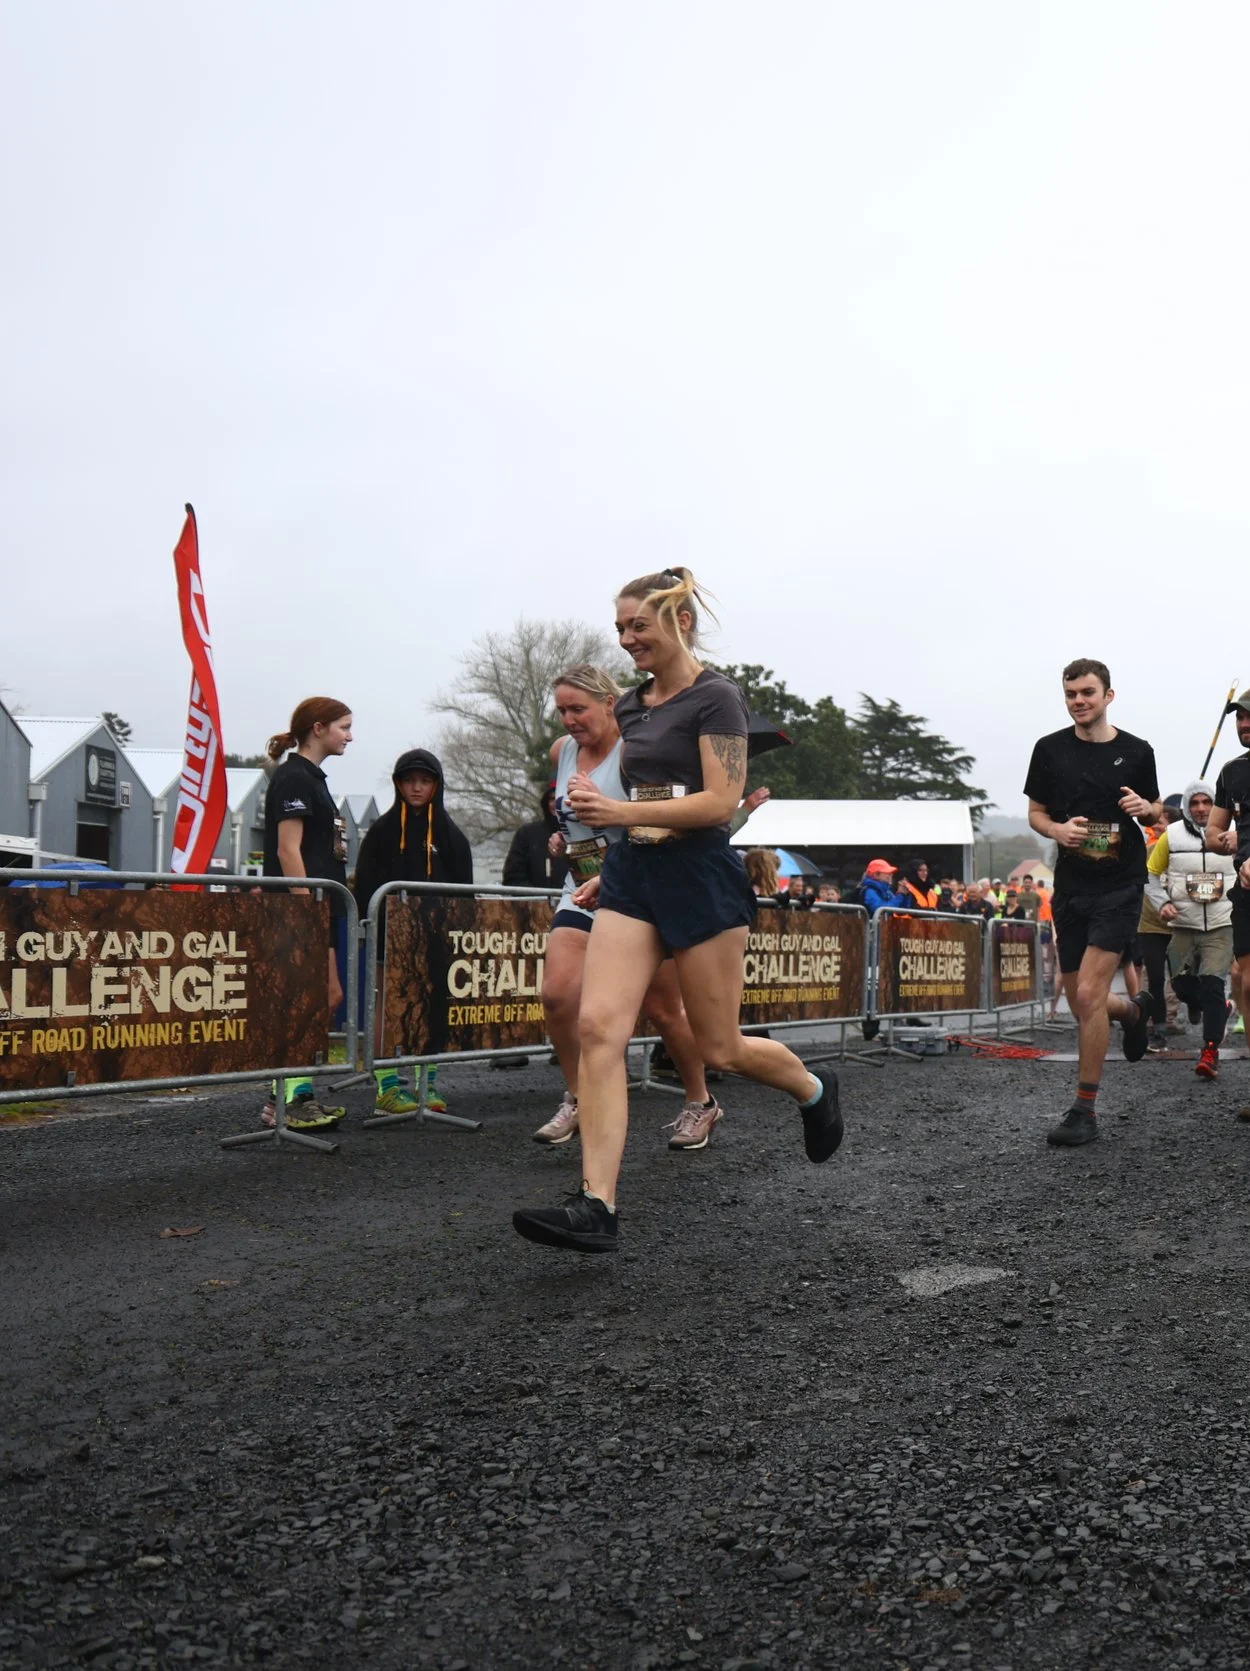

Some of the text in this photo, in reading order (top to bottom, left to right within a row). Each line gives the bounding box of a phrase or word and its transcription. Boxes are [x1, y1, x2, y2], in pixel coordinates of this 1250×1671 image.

[16, 931, 98, 961] GUY
[100, 931, 175, 960] AND
[183, 931, 247, 959] GAL
[449, 930, 550, 955] TOUGH GU
[745, 932, 842, 952] TOUGH GUY AND GAL
[900, 938, 924, 953] TOUGH
[925, 939, 938, 954] GUY
[743, 954, 842, 984] CHALLENGE
[899, 955, 966, 980] CHALLENGE
[0, 965, 247, 1019] LLENGE
[448, 1002, 545, 1025] EXTREME OFF ROA
[32, 1027, 86, 1054] ROAD
[93, 1022, 182, 1050] RUNNING
[190, 1019, 247, 1043] EVENT
